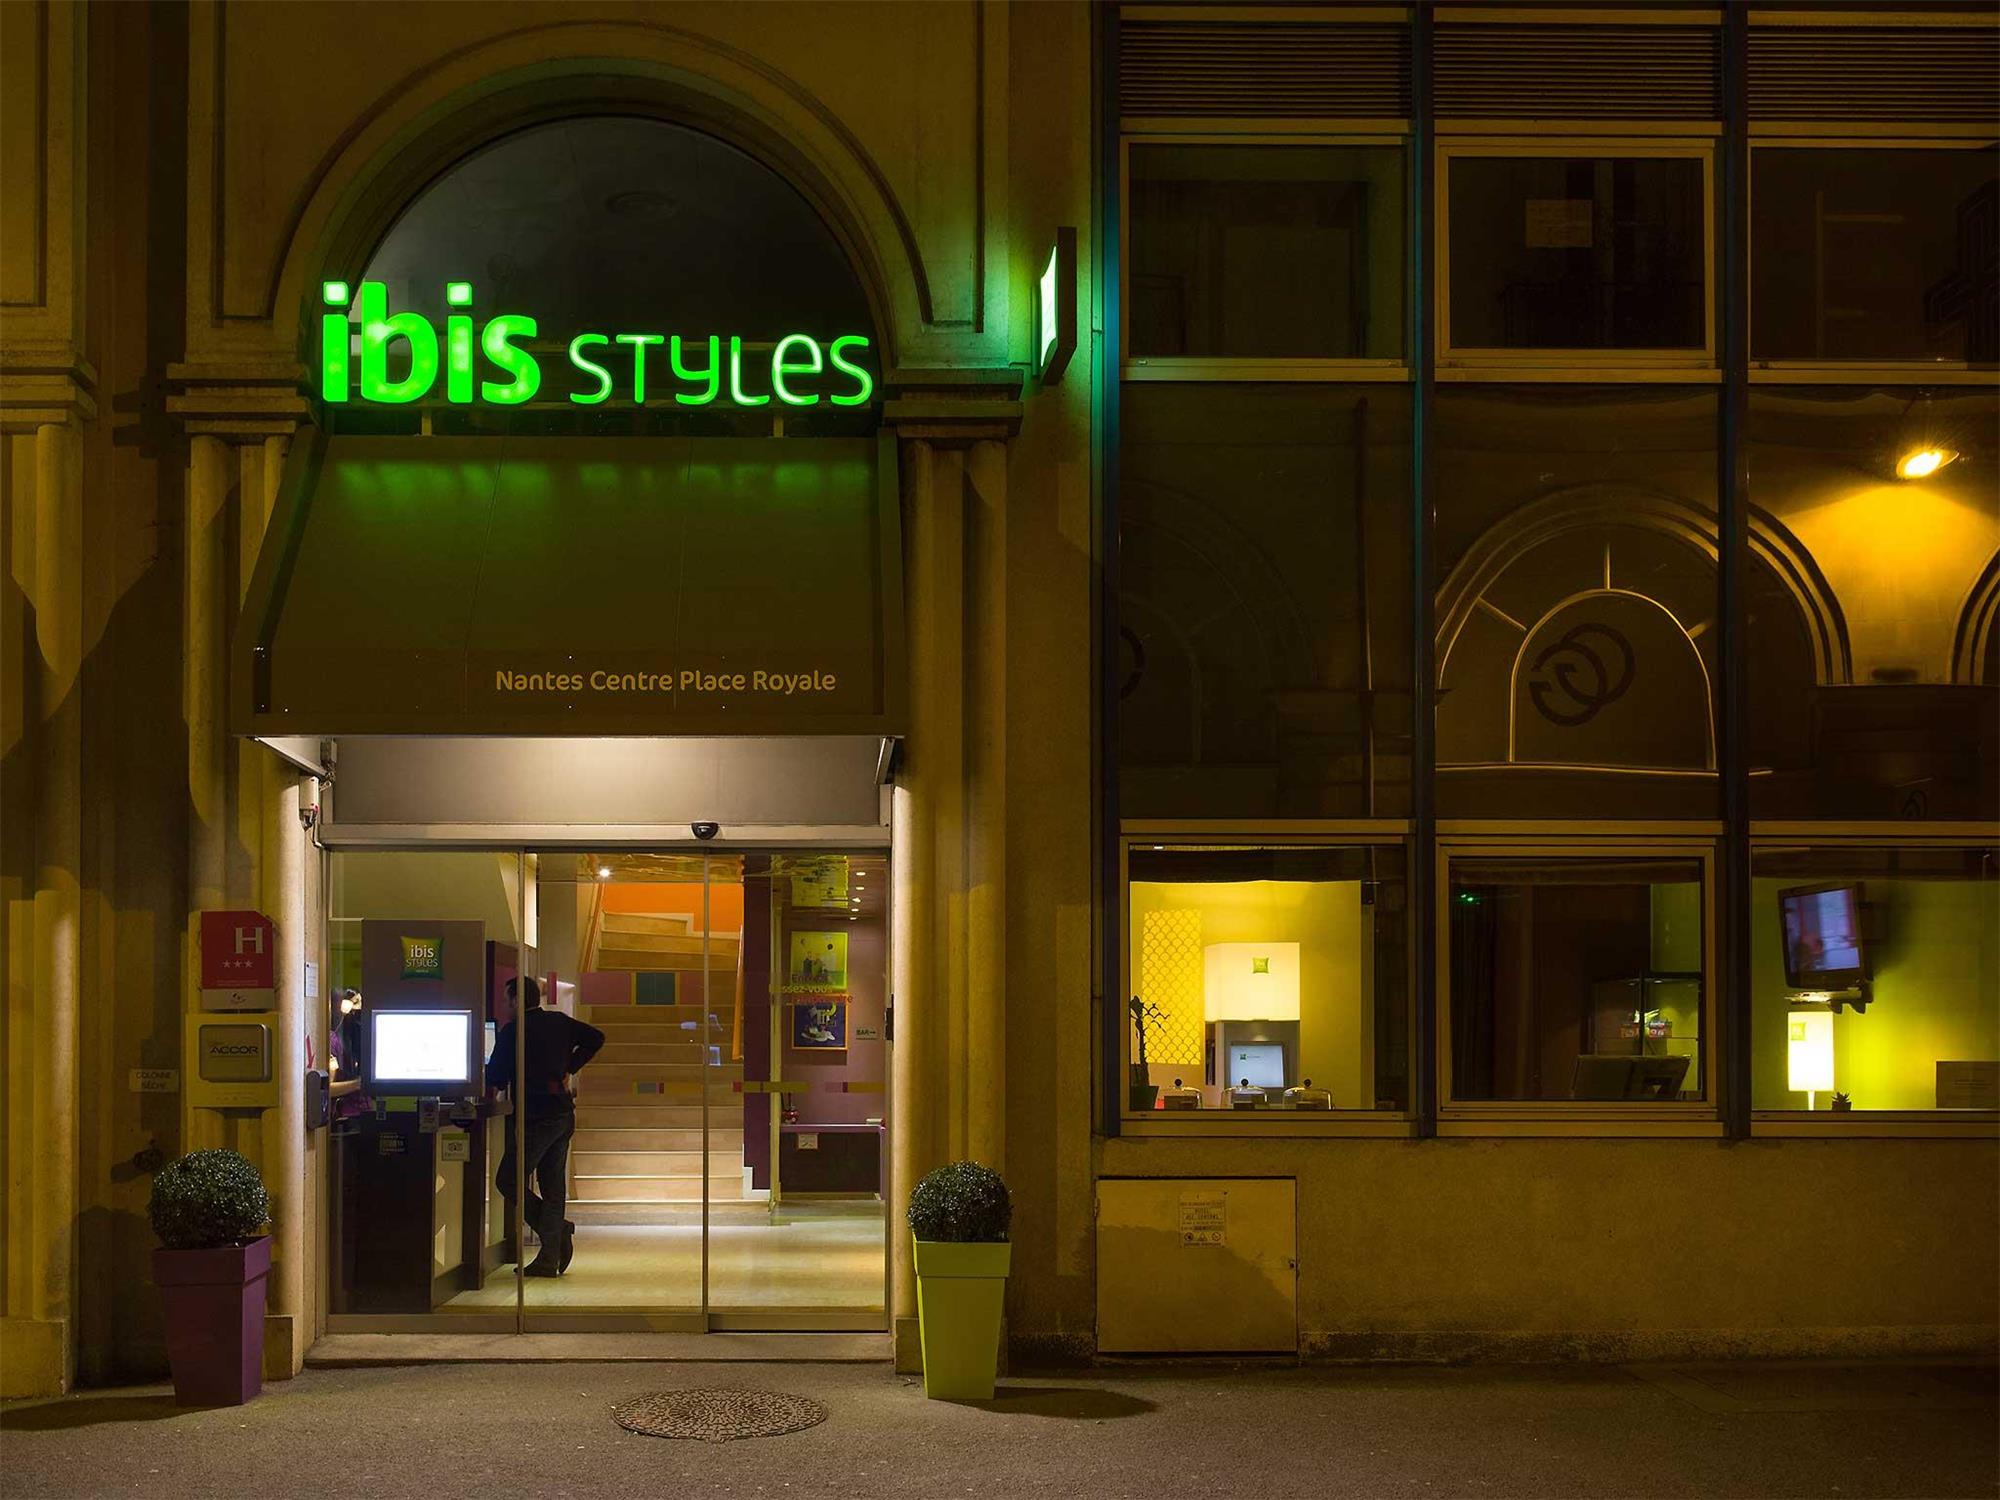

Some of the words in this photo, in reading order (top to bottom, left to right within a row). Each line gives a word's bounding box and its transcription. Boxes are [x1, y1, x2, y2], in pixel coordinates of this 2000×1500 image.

[322, 281, 541, 405] ibis
[496, 670, 583, 691] Nantes
[590, 670, 673, 691] Centre
[680, 670, 746, 691] Place
[753, 670, 836, 695] Royale
[235, 927, 263, 954] H
[410, 944, 434, 958] ibis
[209, 1045, 259, 1055] ACCOR
